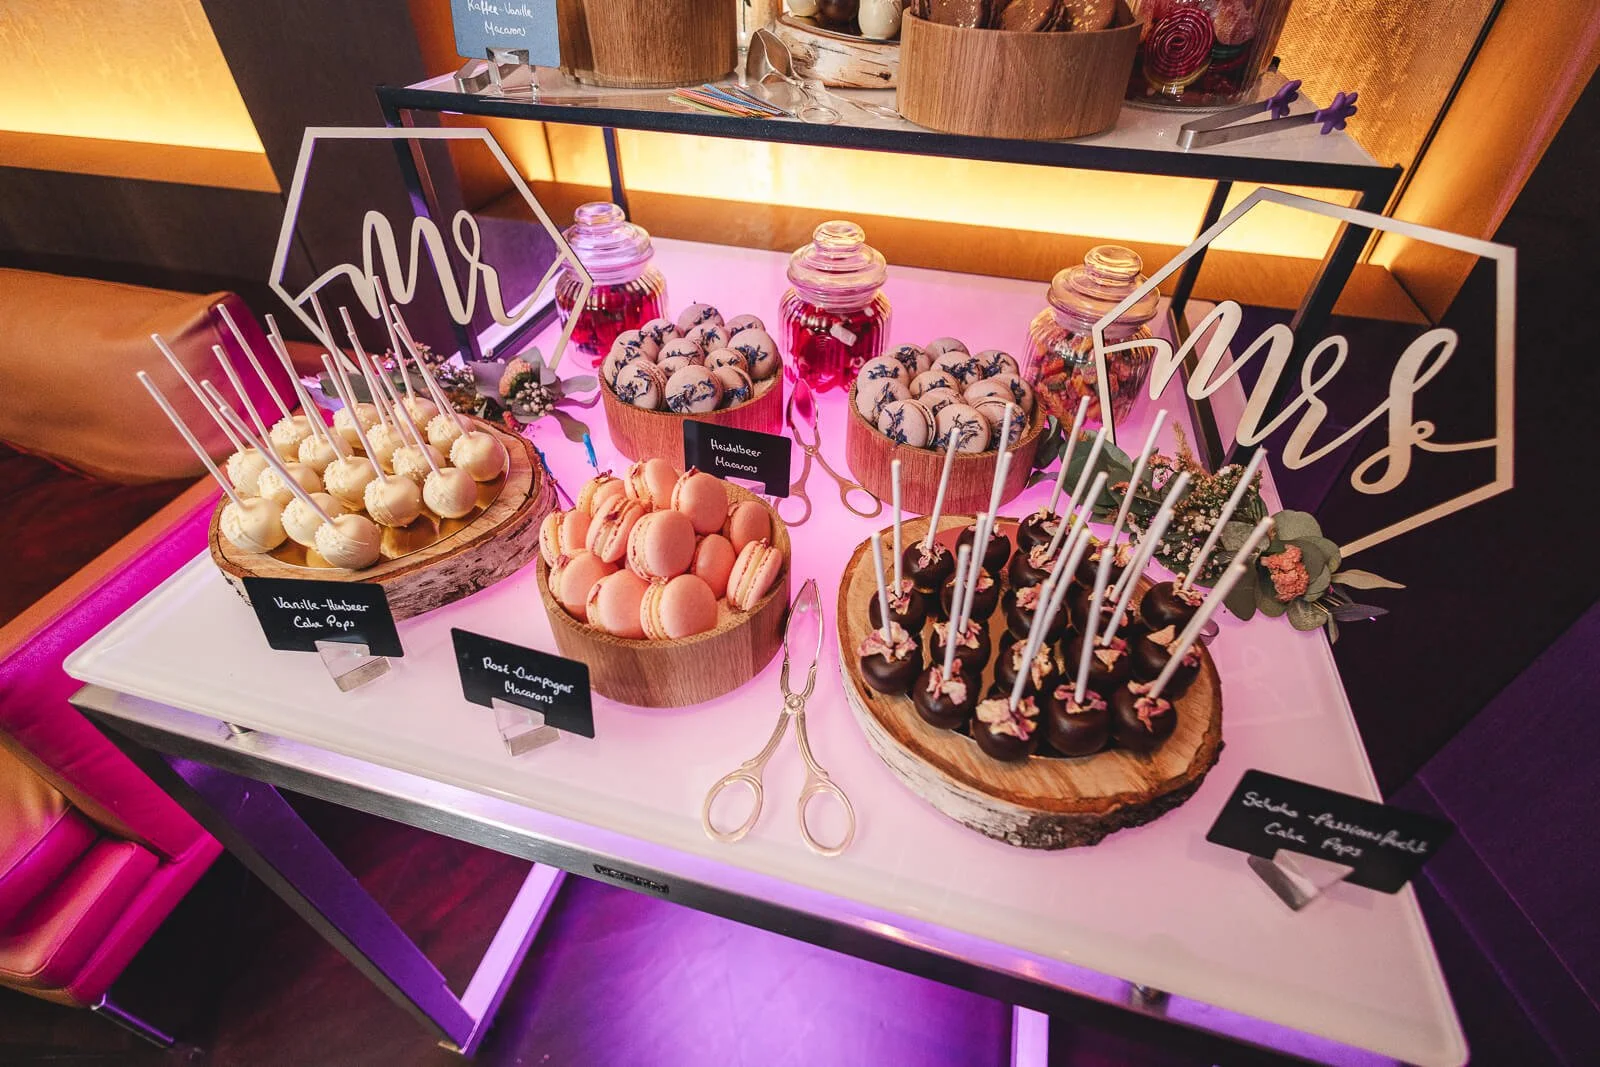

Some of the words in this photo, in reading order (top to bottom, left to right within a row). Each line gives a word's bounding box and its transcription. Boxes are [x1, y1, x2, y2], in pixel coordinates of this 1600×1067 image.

[711, 438, 762, 457] Heidelbeer
[715, 455, 758, 473] Macarons
[293, 615, 323, 628] Cake
[326, 614, 355, 631] Pops
[504, 680, 554, 704] Macarons
[1264, 822, 1307, 844] Cake
[1321, 837, 1364, 857] Pops
